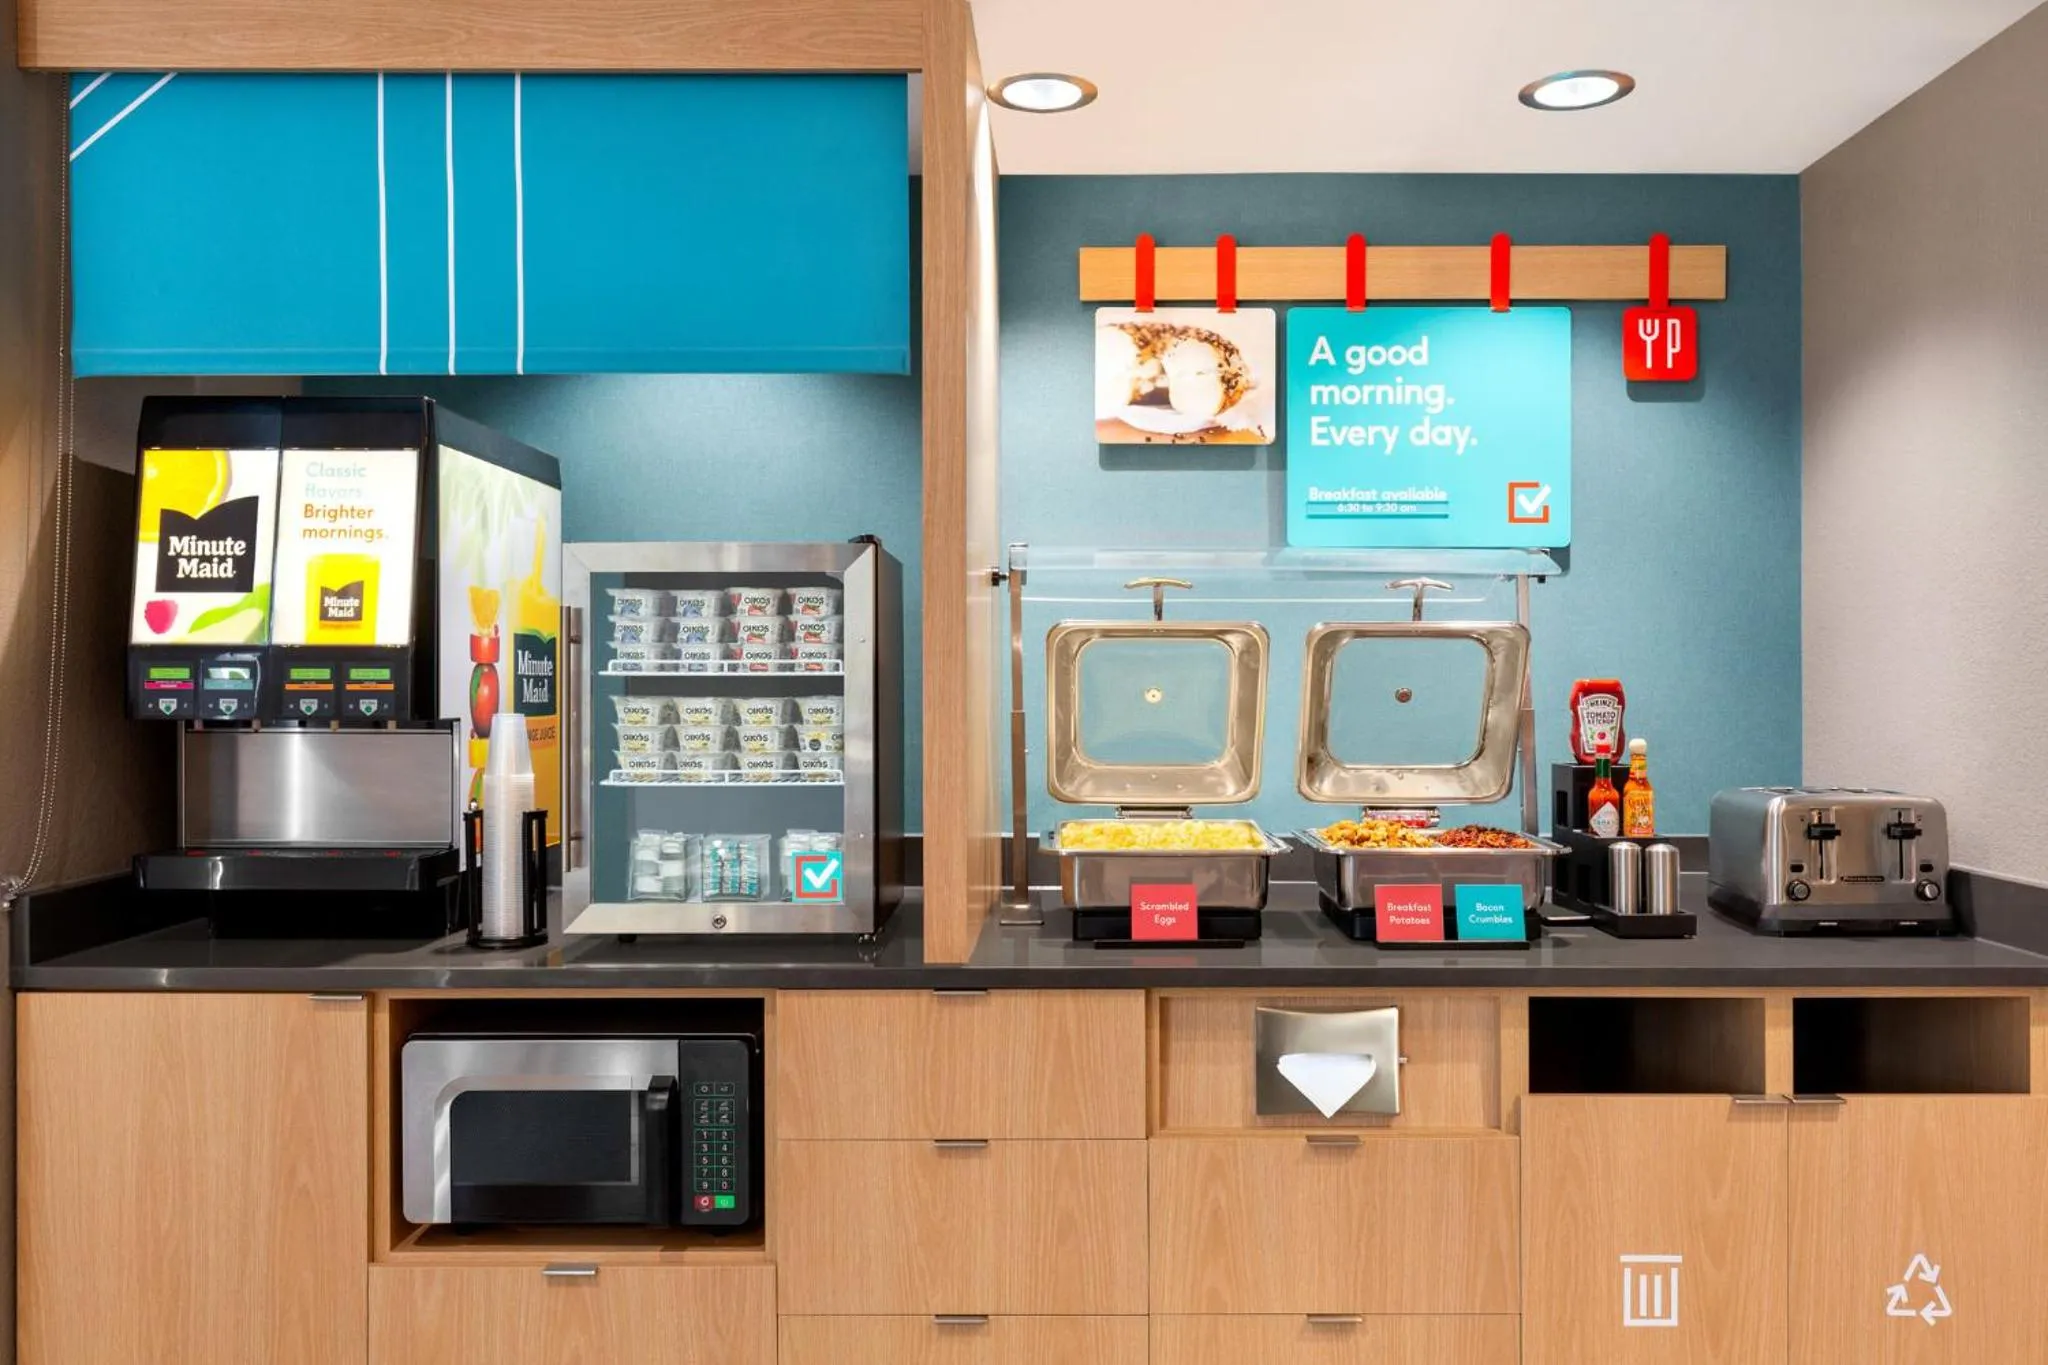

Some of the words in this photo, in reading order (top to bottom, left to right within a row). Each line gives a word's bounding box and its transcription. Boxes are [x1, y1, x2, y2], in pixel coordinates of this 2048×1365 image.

[1308, 335, 1337, 366] A
[1345, 335, 1429, 375] good
[1310, 376, 1455, 414] morning.
[1311, 415, 1399, 456] Every
[1409, 415, 1478, 456] day.
[305, 461, 367, 478] Classic
[1308, 486, 1378, 501] Breakfast
[1380, 486, 1447, 501] available
[303, 503, 374, 523] Brighter
[1362, 503, 1374, 513] to
[1400, 504, 1417, 513] am
[302, 525, 390, 543] mornings.
[167, 535, 247, 556] Minute
[323, 596, 361, 607] Minute
[743, 596, 771, 605] OIKOS
[798, 596, 825, 605] OIKOS
[328, 607, 355, 618] Maid
[682, 625, 710, 634] OIKOS
[742, 625, 770, 633] OIKOS
[799, 623, 826, 632] OIKOS
[745, 651, 772, 660] OIKOS
[800, 651, 827, 660] OIKOS
[517, 649, 553, 676] Minute
[522, 678, 549, 703] Maid
[1589, 699, 1612, 707] HEINZ
[685, 706, 713, 715] OIKOS
[746, 706, 774, 715] OIKOS
[807, 706, 835, 715] OIKOS
[1586, 711, 1616, 719] TOMATO
[622, 733, 650, 742] OIKOS
[684, 733, 711, 742] OIKOS
[742, 733, 769, 742] OIKOS
[746, 760, 774, 769] OIKOS
[802, 760, 829, 768] OIKOS
[1139, 901, 1189, 911] Scrambled
[1386, 902, 1432, 912] Breakfast
[1475, 902, 1505, 912] Bacon
[1153, 913, 1177, 926] Eggs
[1389, 915, 1431, 925] Potatoes
[1468, 914, 1513, 924] Crumbles
